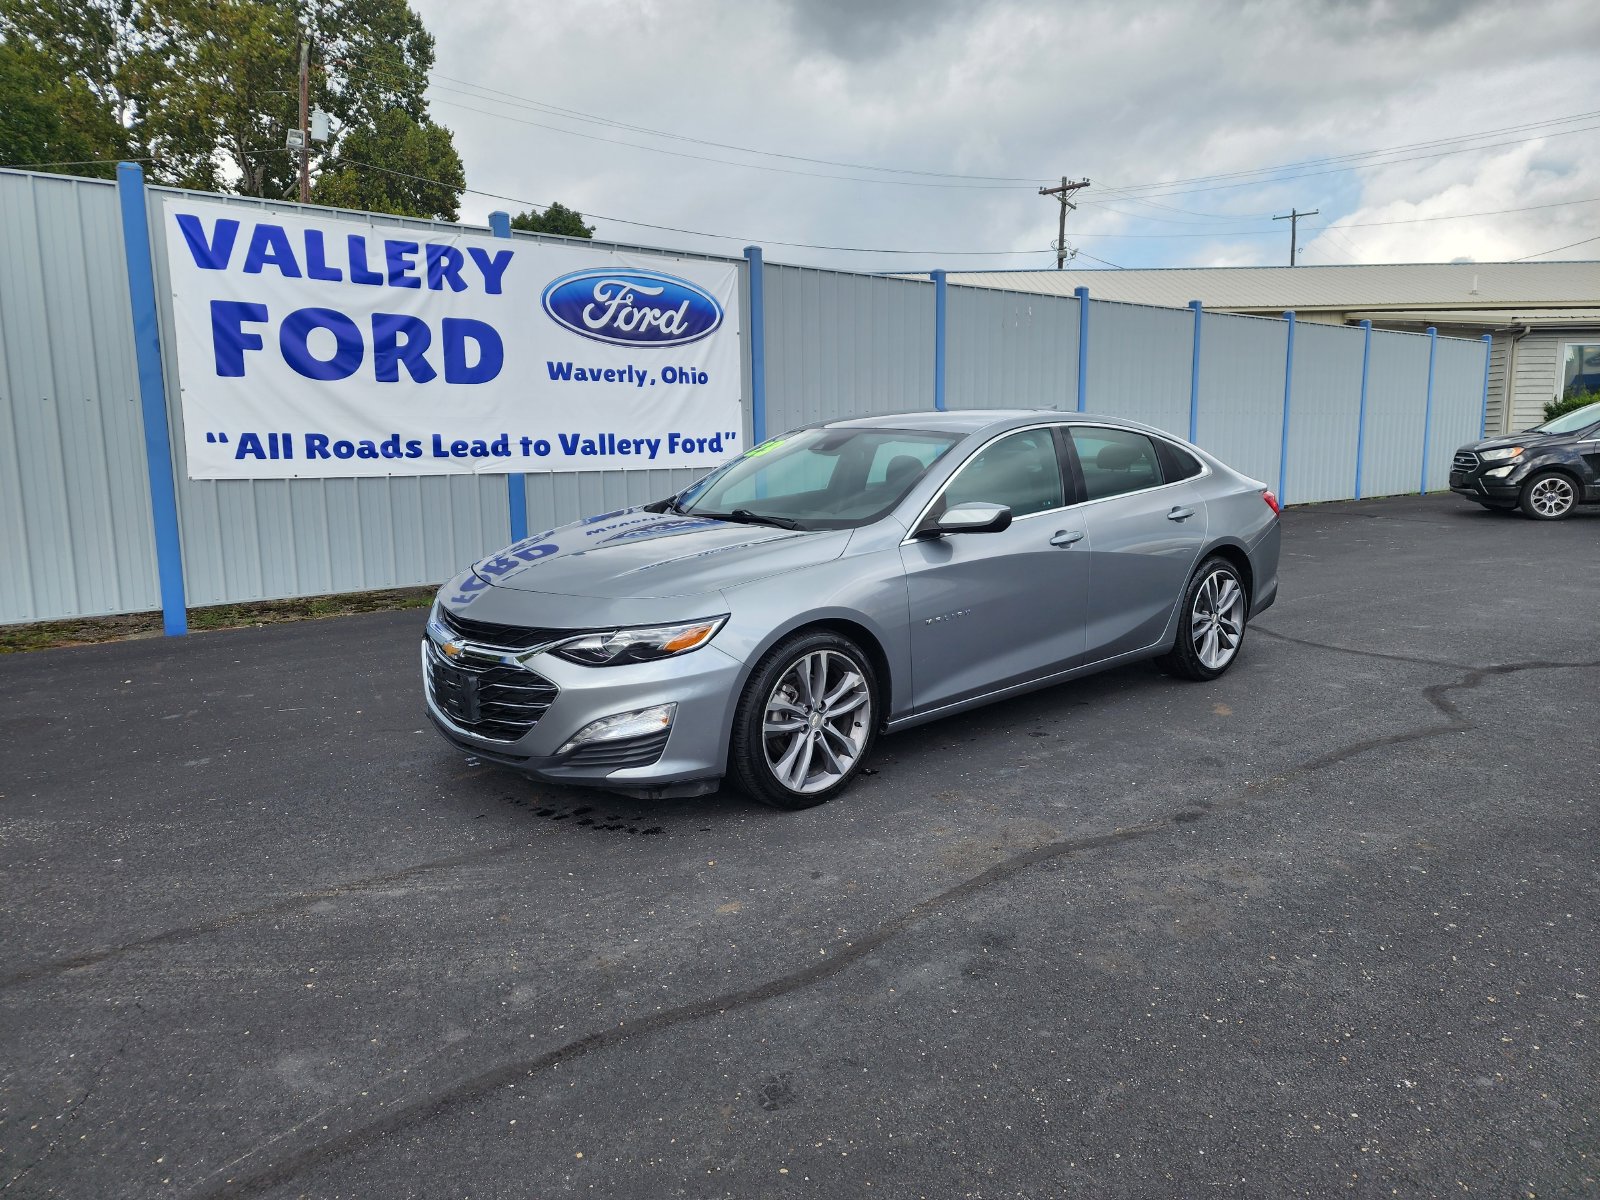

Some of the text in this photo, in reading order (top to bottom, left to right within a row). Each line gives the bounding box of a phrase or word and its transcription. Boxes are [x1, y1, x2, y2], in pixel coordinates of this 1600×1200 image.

[175, 213, 515, 295] VALLERY
[582, 279, 690, 335] Ford
[209, 299, 505, 385] FORD
[546, 361, 709, 387] Waverly, Ohio
[304, 433, 423, 460] Roads
[432, 433, 512, 458] Lead
[519, 436, 551, 457] to
[557, 433, 661, 460] Vallery
